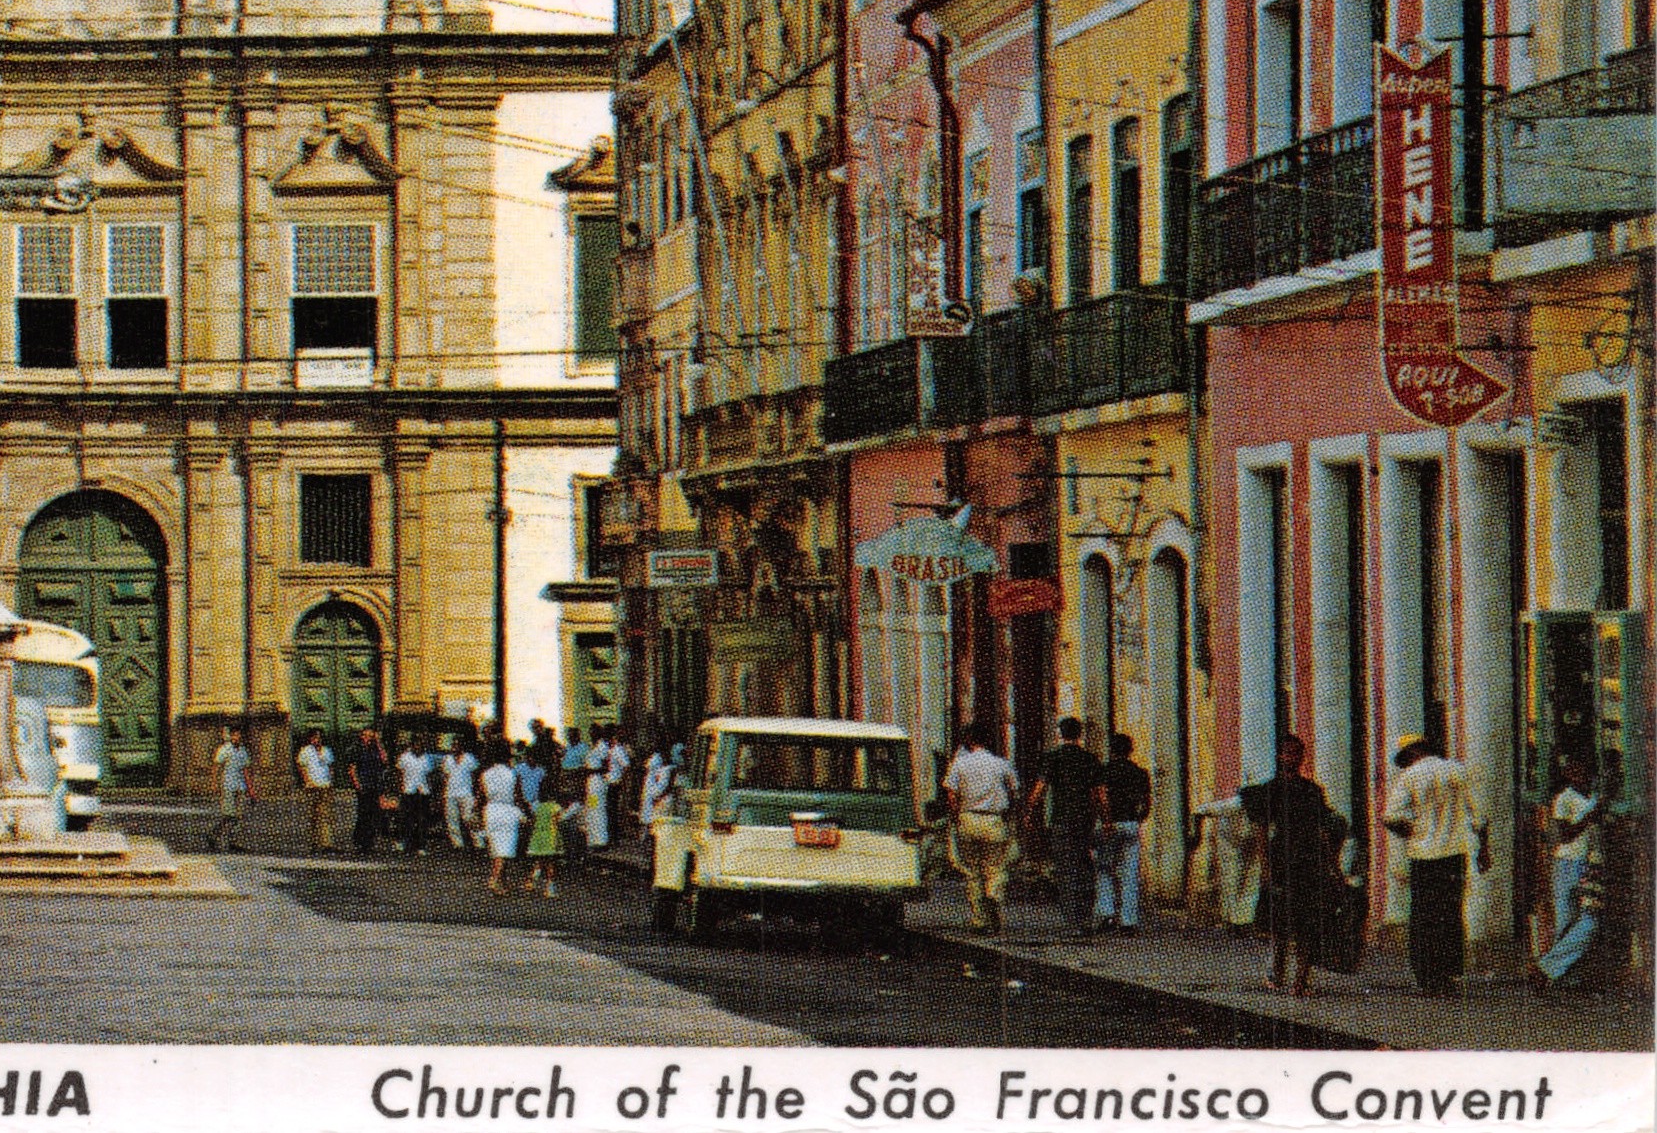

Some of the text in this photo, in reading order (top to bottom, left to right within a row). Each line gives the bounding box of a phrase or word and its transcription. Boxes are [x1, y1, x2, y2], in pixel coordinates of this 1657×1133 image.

[1402, 103, 1434, 272] HENE
[1395, 364, 1460, 390] AQUI
[891, 554, 971, 581] BRASIL
